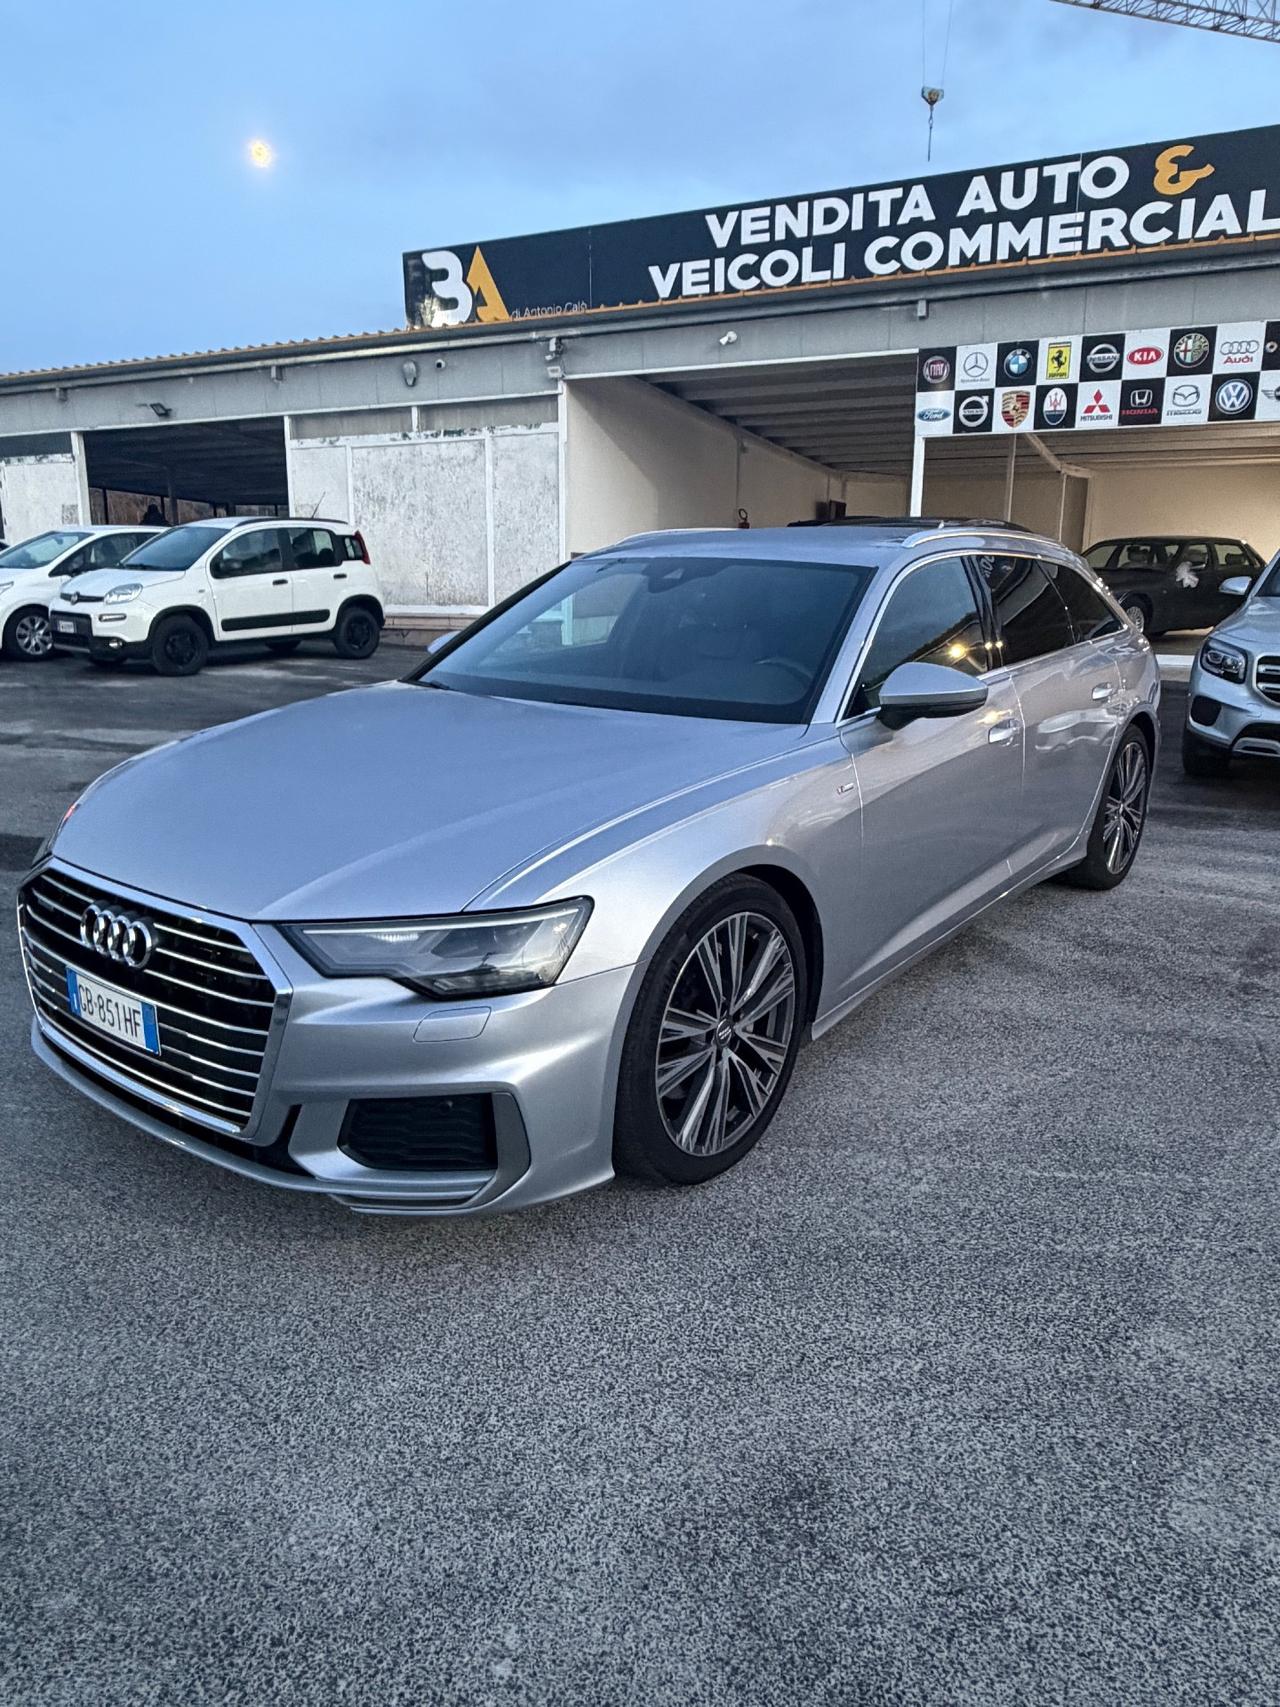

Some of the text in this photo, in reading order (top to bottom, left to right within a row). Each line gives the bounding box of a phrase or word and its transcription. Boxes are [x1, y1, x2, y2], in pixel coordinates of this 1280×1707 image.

[705, 144, 1215, 249] VENDITA AUTO &
[648, 189, 1280, 299] VEICOLI COMMERCIAL
[523, 303, 563, 318] Antonio
[1089, 353, 1118, 363] NISSAN
[1133, 350, 1157, 362] KIA
[1223, 355, 1254, 365] Audi
[1121, 408, 1159, 416] HONDA
[1080, 414, 1113, 422] MITSUBISHI
